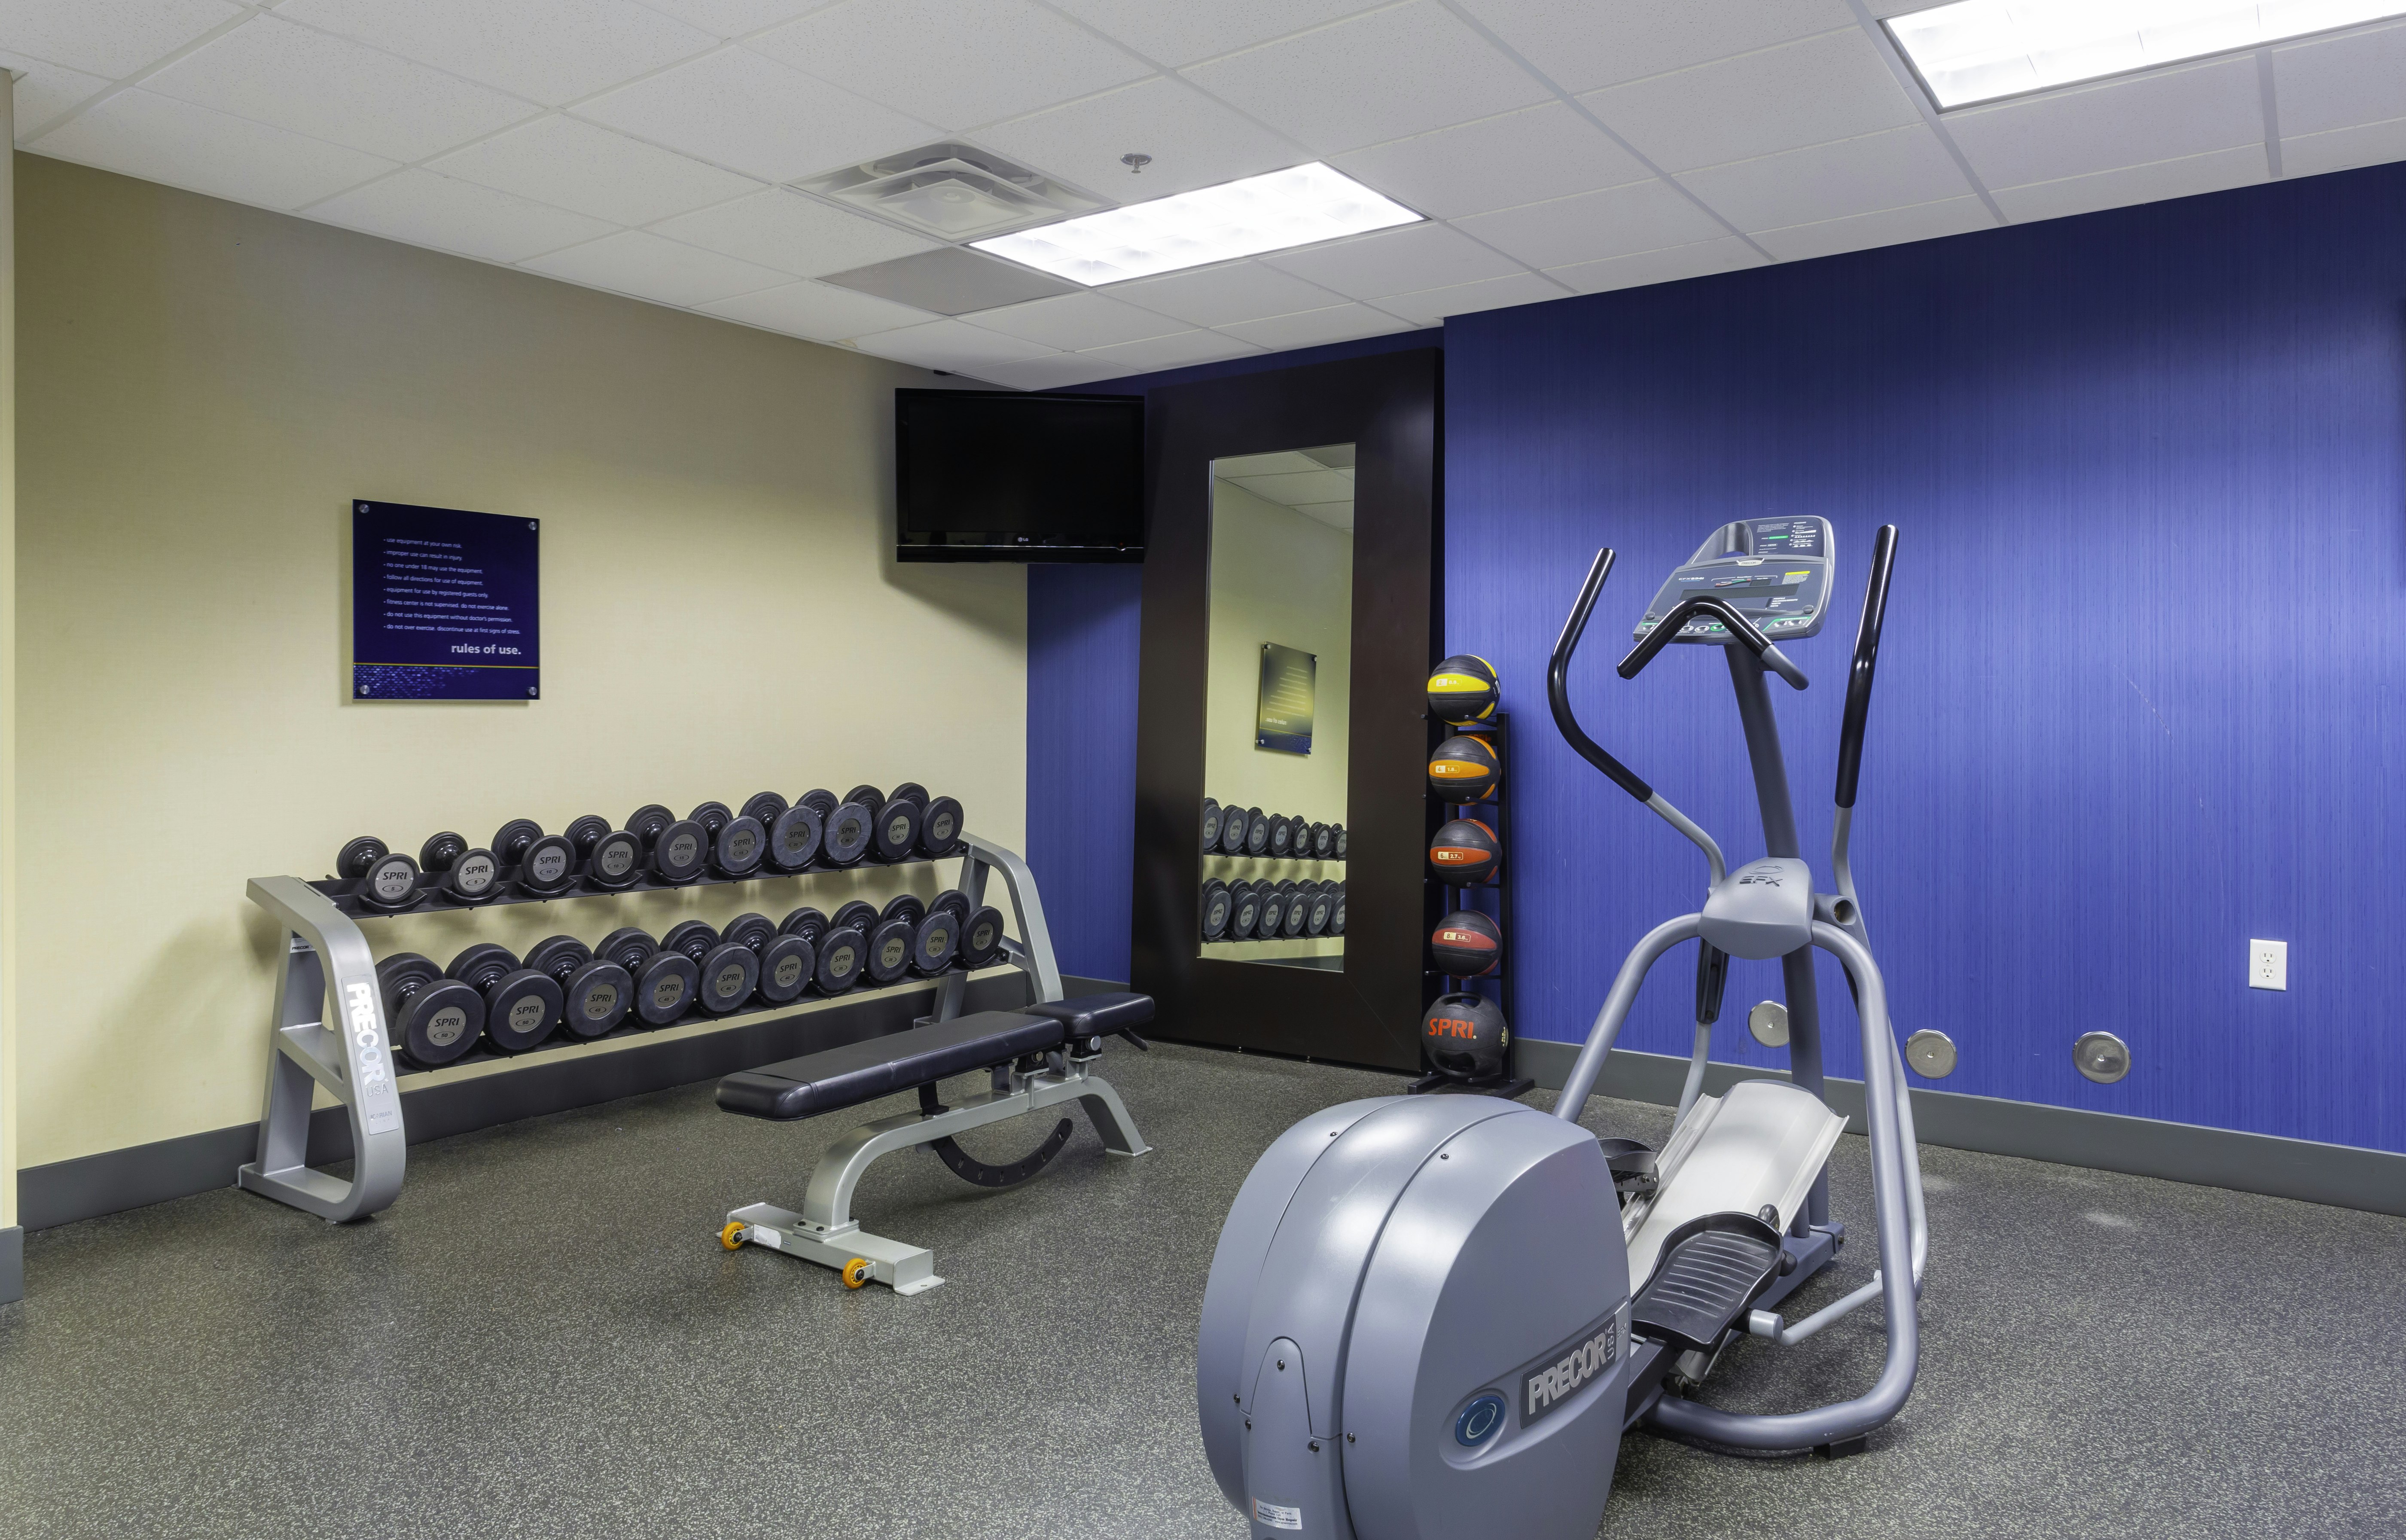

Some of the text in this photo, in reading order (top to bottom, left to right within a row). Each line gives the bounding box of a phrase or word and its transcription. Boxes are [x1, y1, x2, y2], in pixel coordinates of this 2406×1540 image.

[451, 643, 480, 653] rules
[483, 644, 496, 653] of
[937, 820, 950, 828] SPRI
[733, 838, 751, 847] SPRI
[540, 856, 561, 864] SPRI
[465, 865, 488, 875] SPRI
[1739, 876, 1783, 887] EFX
[835, 954, 850, 962] SPRI
[780, 963, 797, 972] SPRI
[722, 973, 740, 982] SPRI
[516, 1006, 539, 1015] SPRI
[435, 1018, 459, 1027] SPRI
[347, 982, 385, 1086] PRECOR
[366, 1083, 388, 1096] USA
[1529, 1333, 1607, 1415] PRECOR
